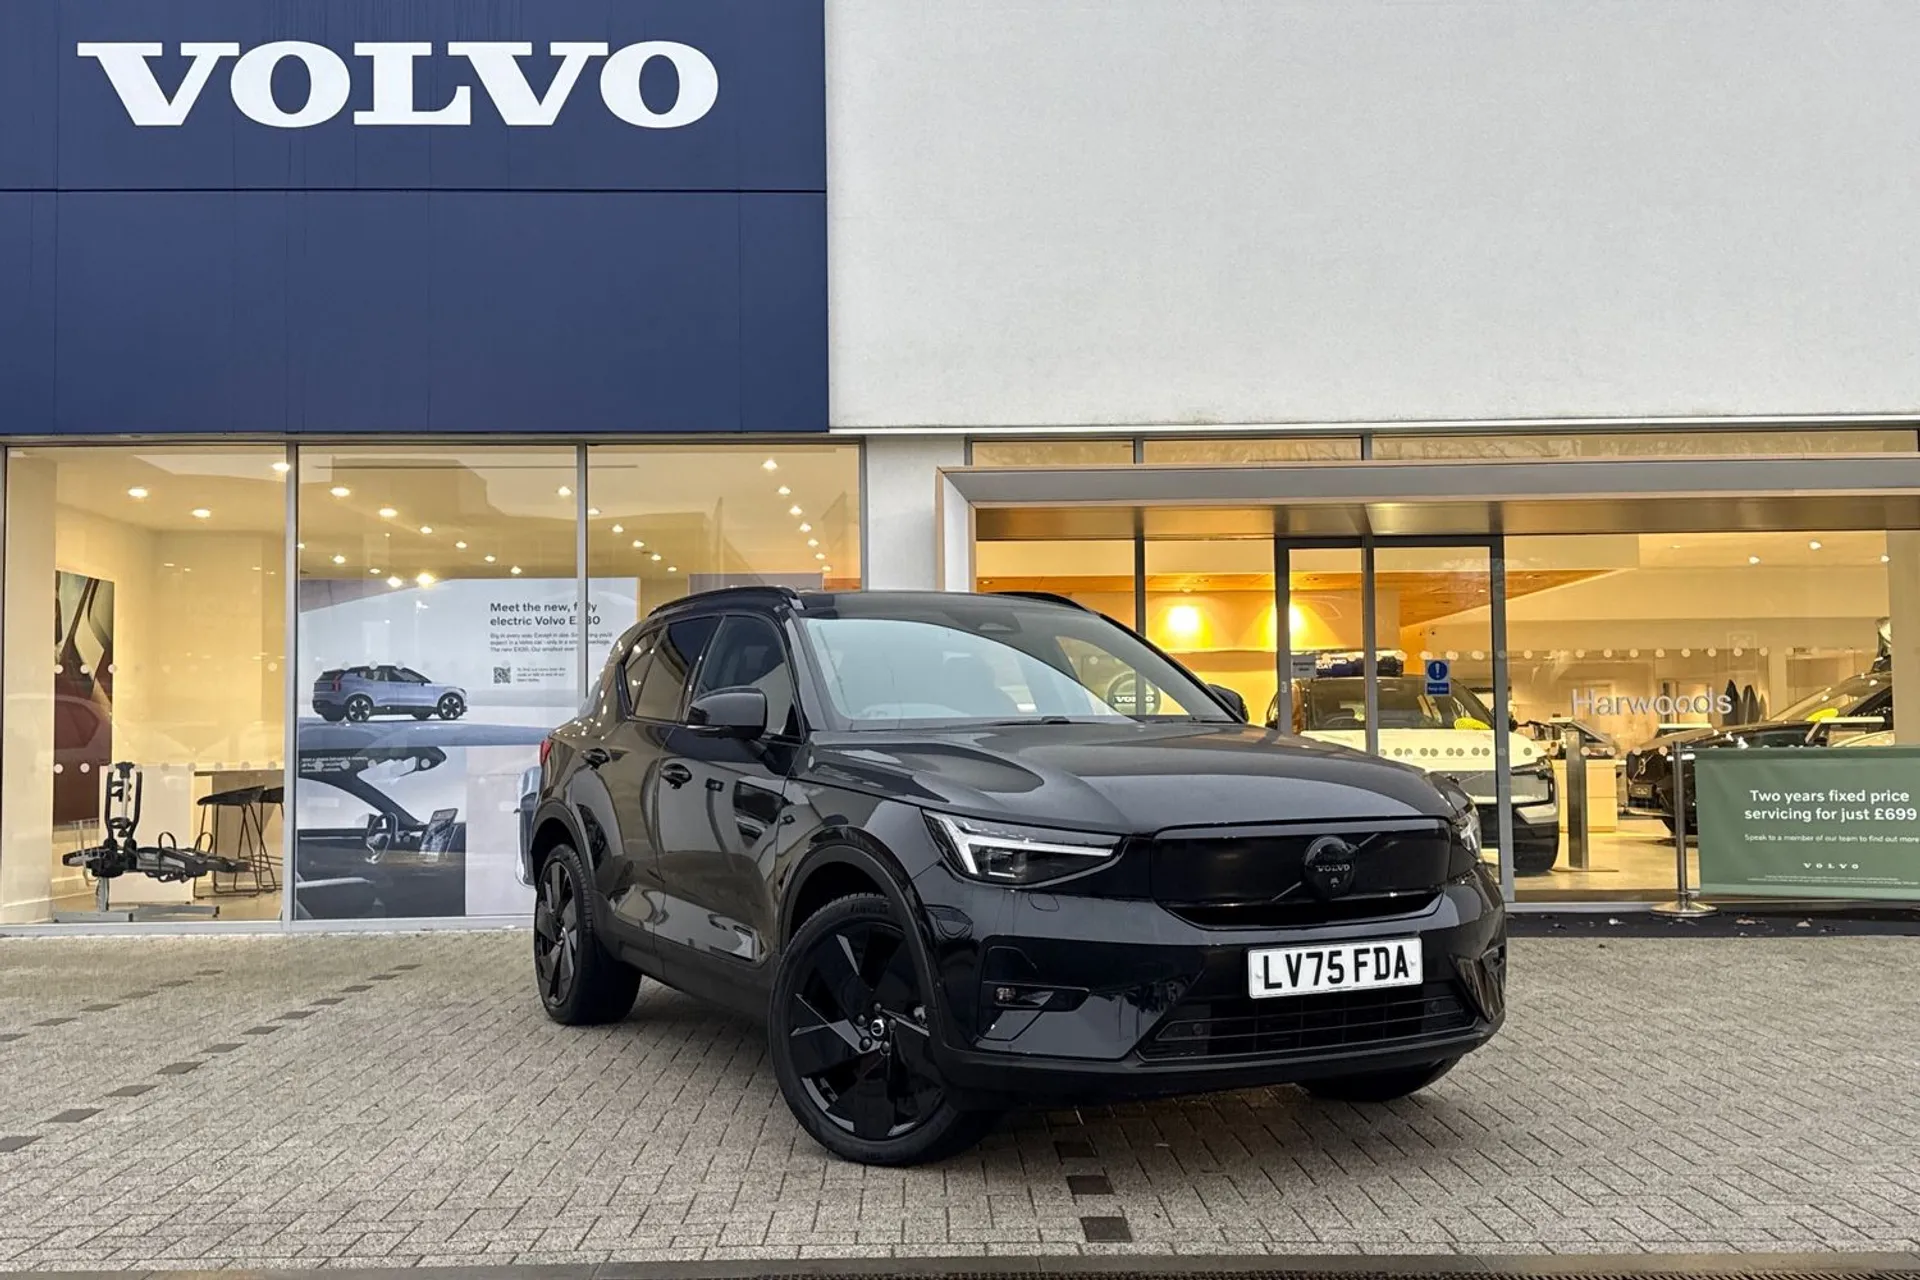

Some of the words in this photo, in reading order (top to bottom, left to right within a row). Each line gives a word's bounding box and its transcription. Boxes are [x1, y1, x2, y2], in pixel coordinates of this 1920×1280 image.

[77, 40, 719, 129] VOLVO
[490, 603, 520, 612] Meet
[522, 602, 541, 612] the
[544, 604, 571, 613] new,
[573, 601, 598, 613] fly
[490, 616, 532, 626] electric
[535, 616, 566, 626] Volvo
[569, 616, 601, 625] E30
[1572, 687, 1733, 716] Harwoods
[1749, 789, 1781, 802] Two
[1784, 791, 1825, 804] years
[1828, 789, 1866, 802] fixed
[1870, 789, 1910, 804] price
[1744, 807, 1812, 822] servicing
[1815, 807, 1838, 820] for
[1840, 807, 1870, 823] just
[1874, 807, 1918, 821] £699
[1744, 834, 1767, 842] Speak
[1868, 834, 1884, 842] find
[1315, 863, 1351, 872] VOLVO
[1803, 862, 1859, 870] VOLVO
[1263, 950, 1344, 989] LV75
[1353, 945, 1409, 983] FDA
